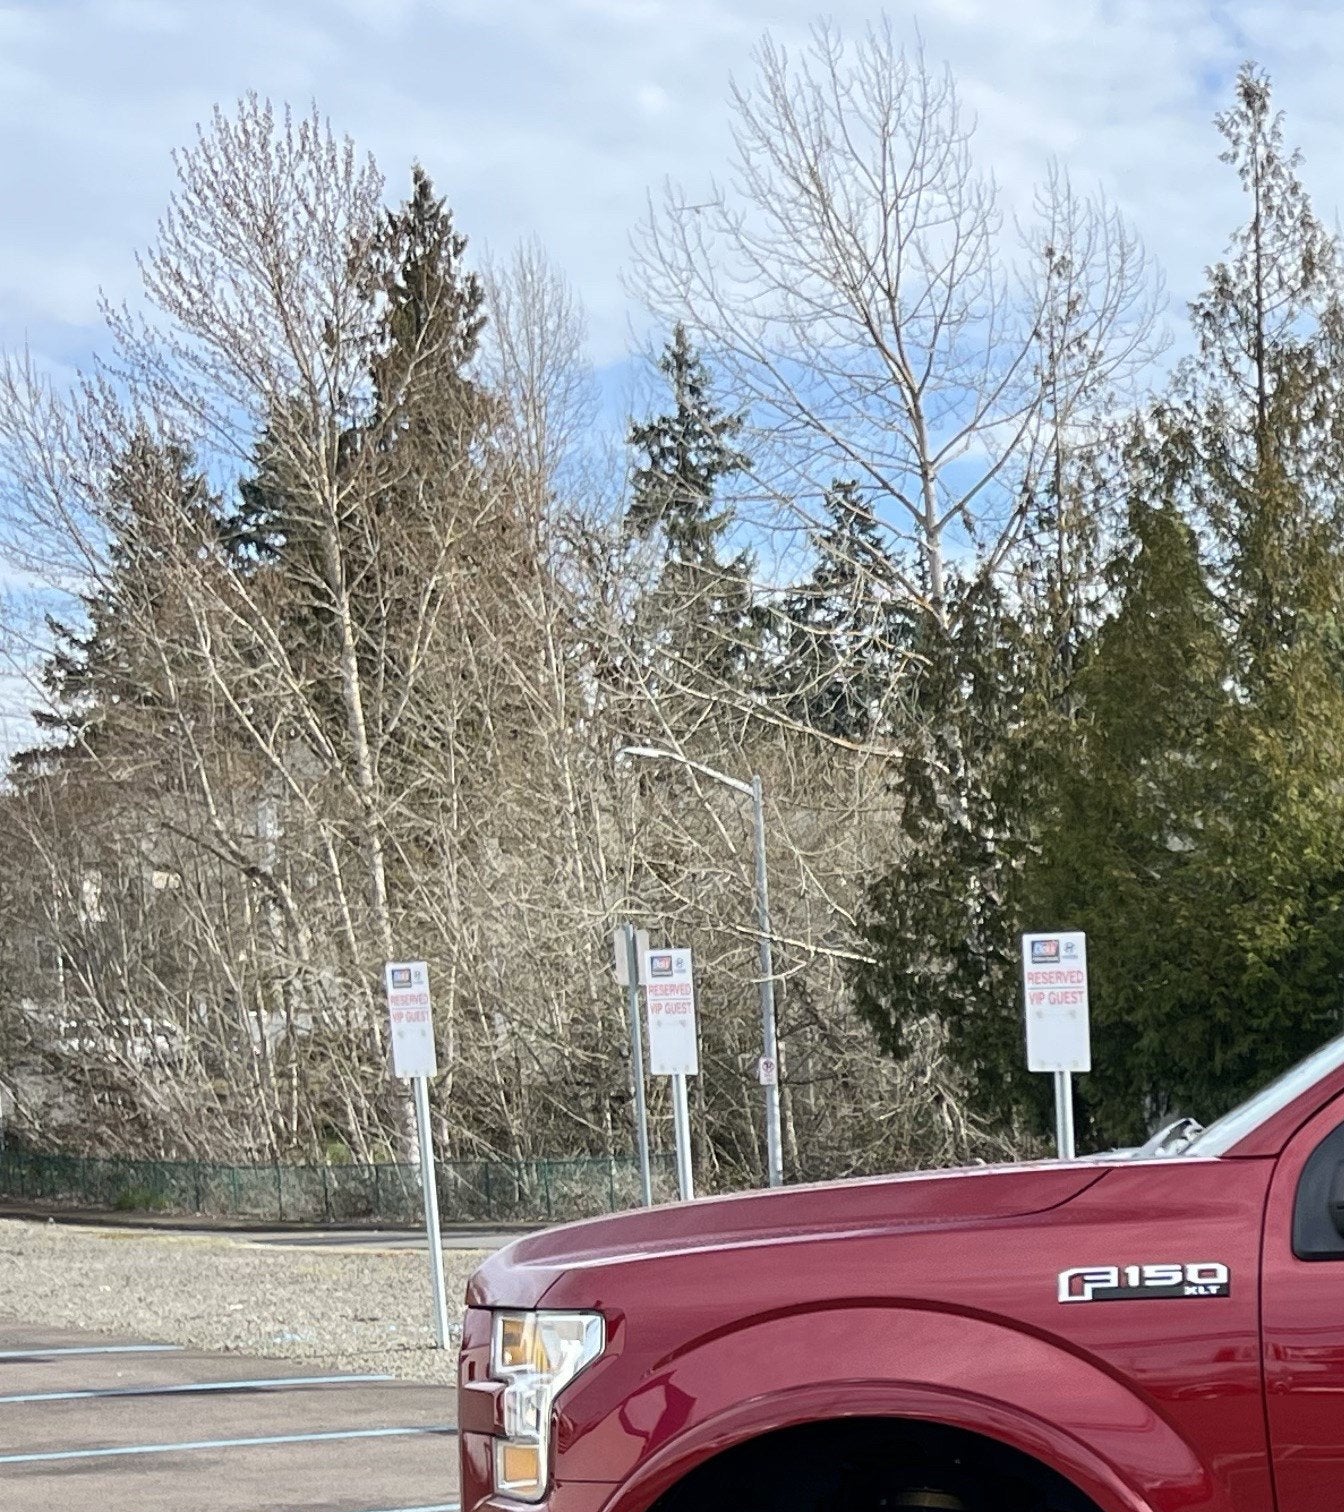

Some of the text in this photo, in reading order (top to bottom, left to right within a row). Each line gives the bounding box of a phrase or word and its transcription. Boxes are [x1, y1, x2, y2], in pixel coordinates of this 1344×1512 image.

[1027, 970, 1084, 985] RESERVED
[648, 983, 692, 997] RESERVED
[1029, 990, 1084, 1005] VIP GUEST
[650, 1002, 692, 1015] VIP GUEST
[1184, 1285, 1221, 1295] XLT
